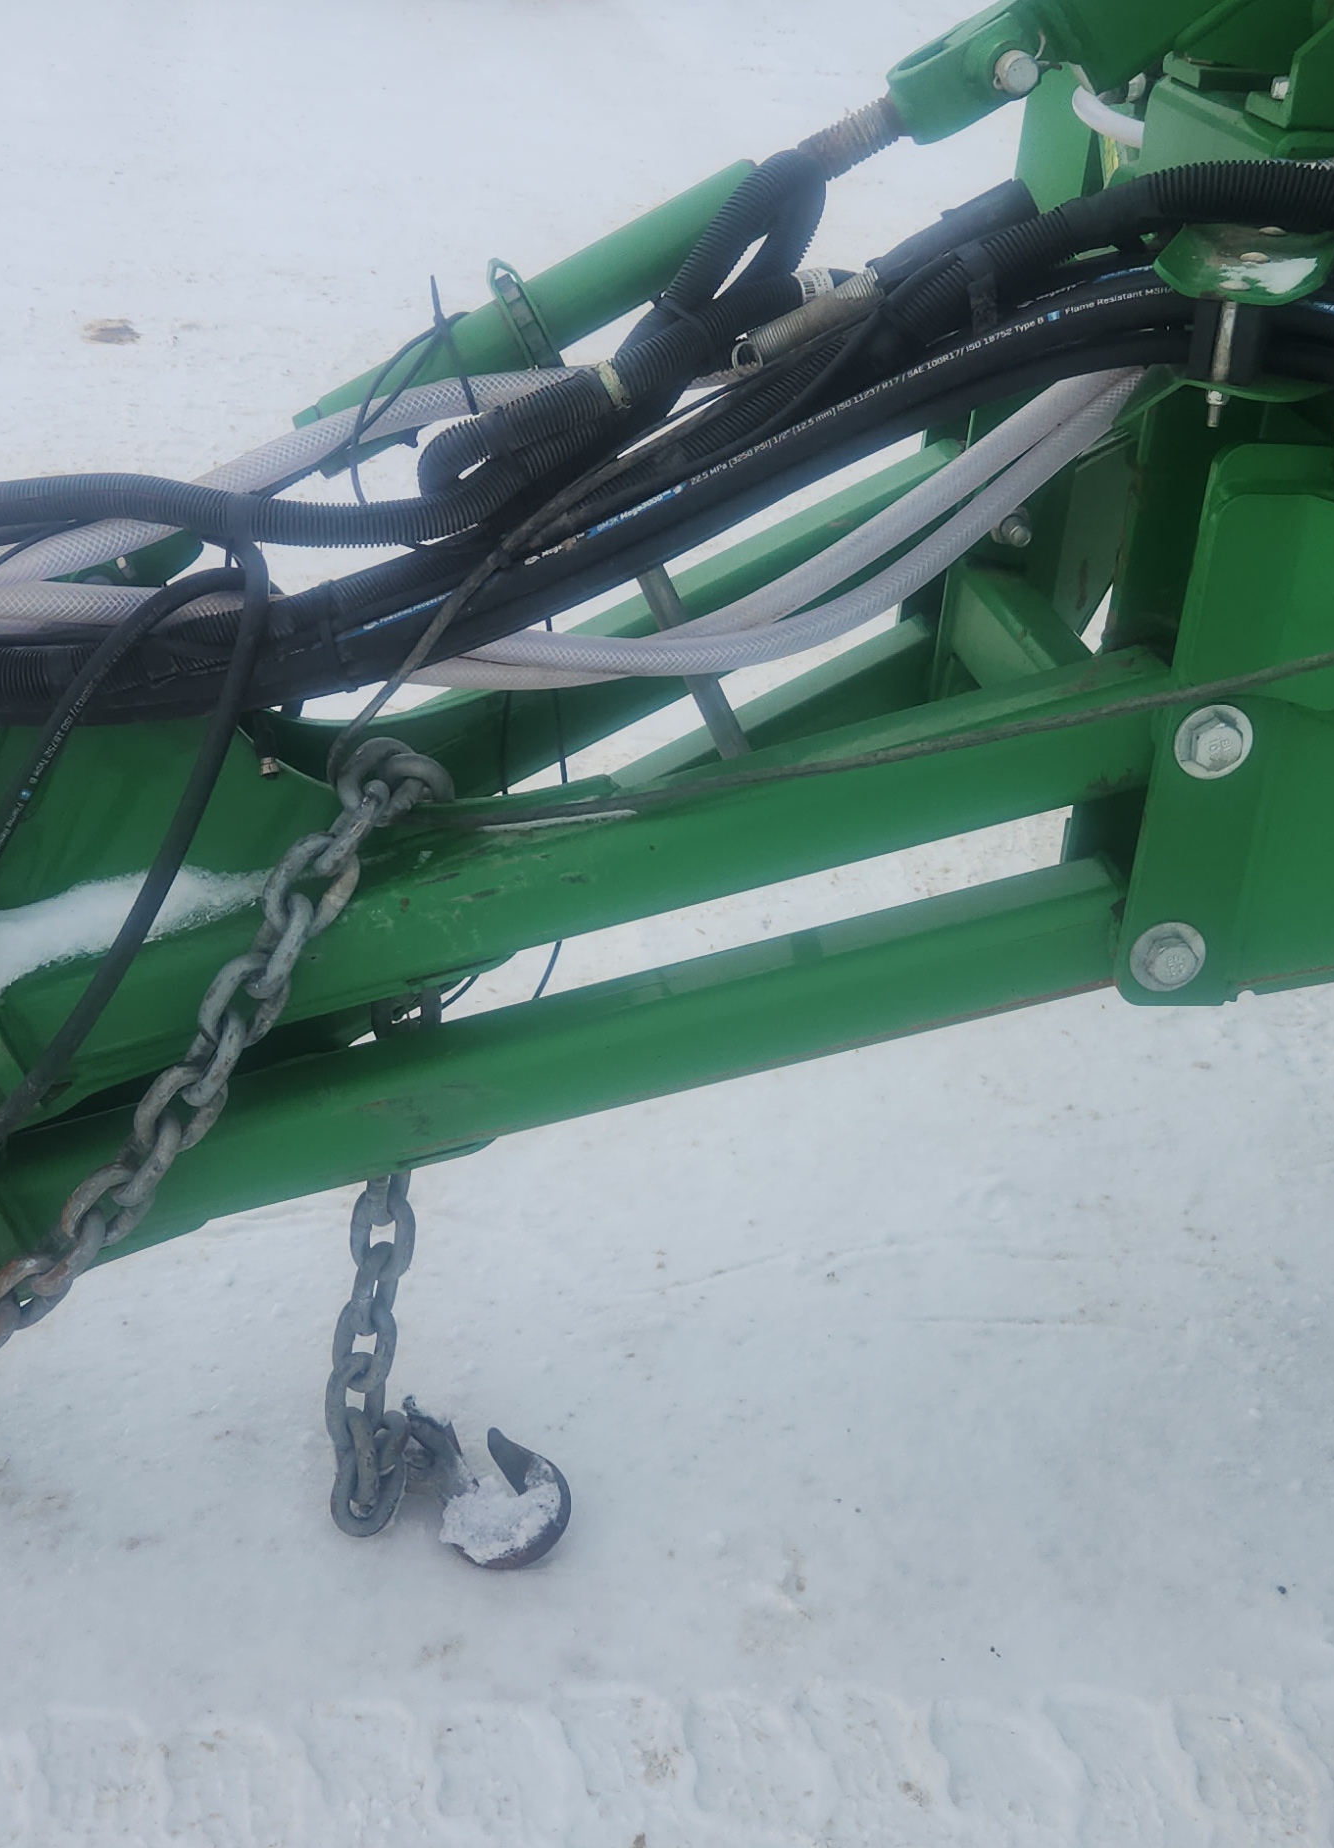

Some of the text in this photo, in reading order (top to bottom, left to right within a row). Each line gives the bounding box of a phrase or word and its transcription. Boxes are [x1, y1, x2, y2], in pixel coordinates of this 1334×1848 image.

[689, 470, 709, 486] 22.5
[709, 462, 728, 476] MPa
[836, 400, 853, 412] ISO
[853, 384, 881, 404] 11237
[881, 376, 900, 390] R17
[907, 364, 925, 379] SAE
[983, 327, 1013, 346] 18752
[1013, 318, 1037, 335] Type
[1036, 315, 1045, 326] B
[1064, 300, 1096, 316] Flame
[1096, 288, 1144, 307] Resistant
